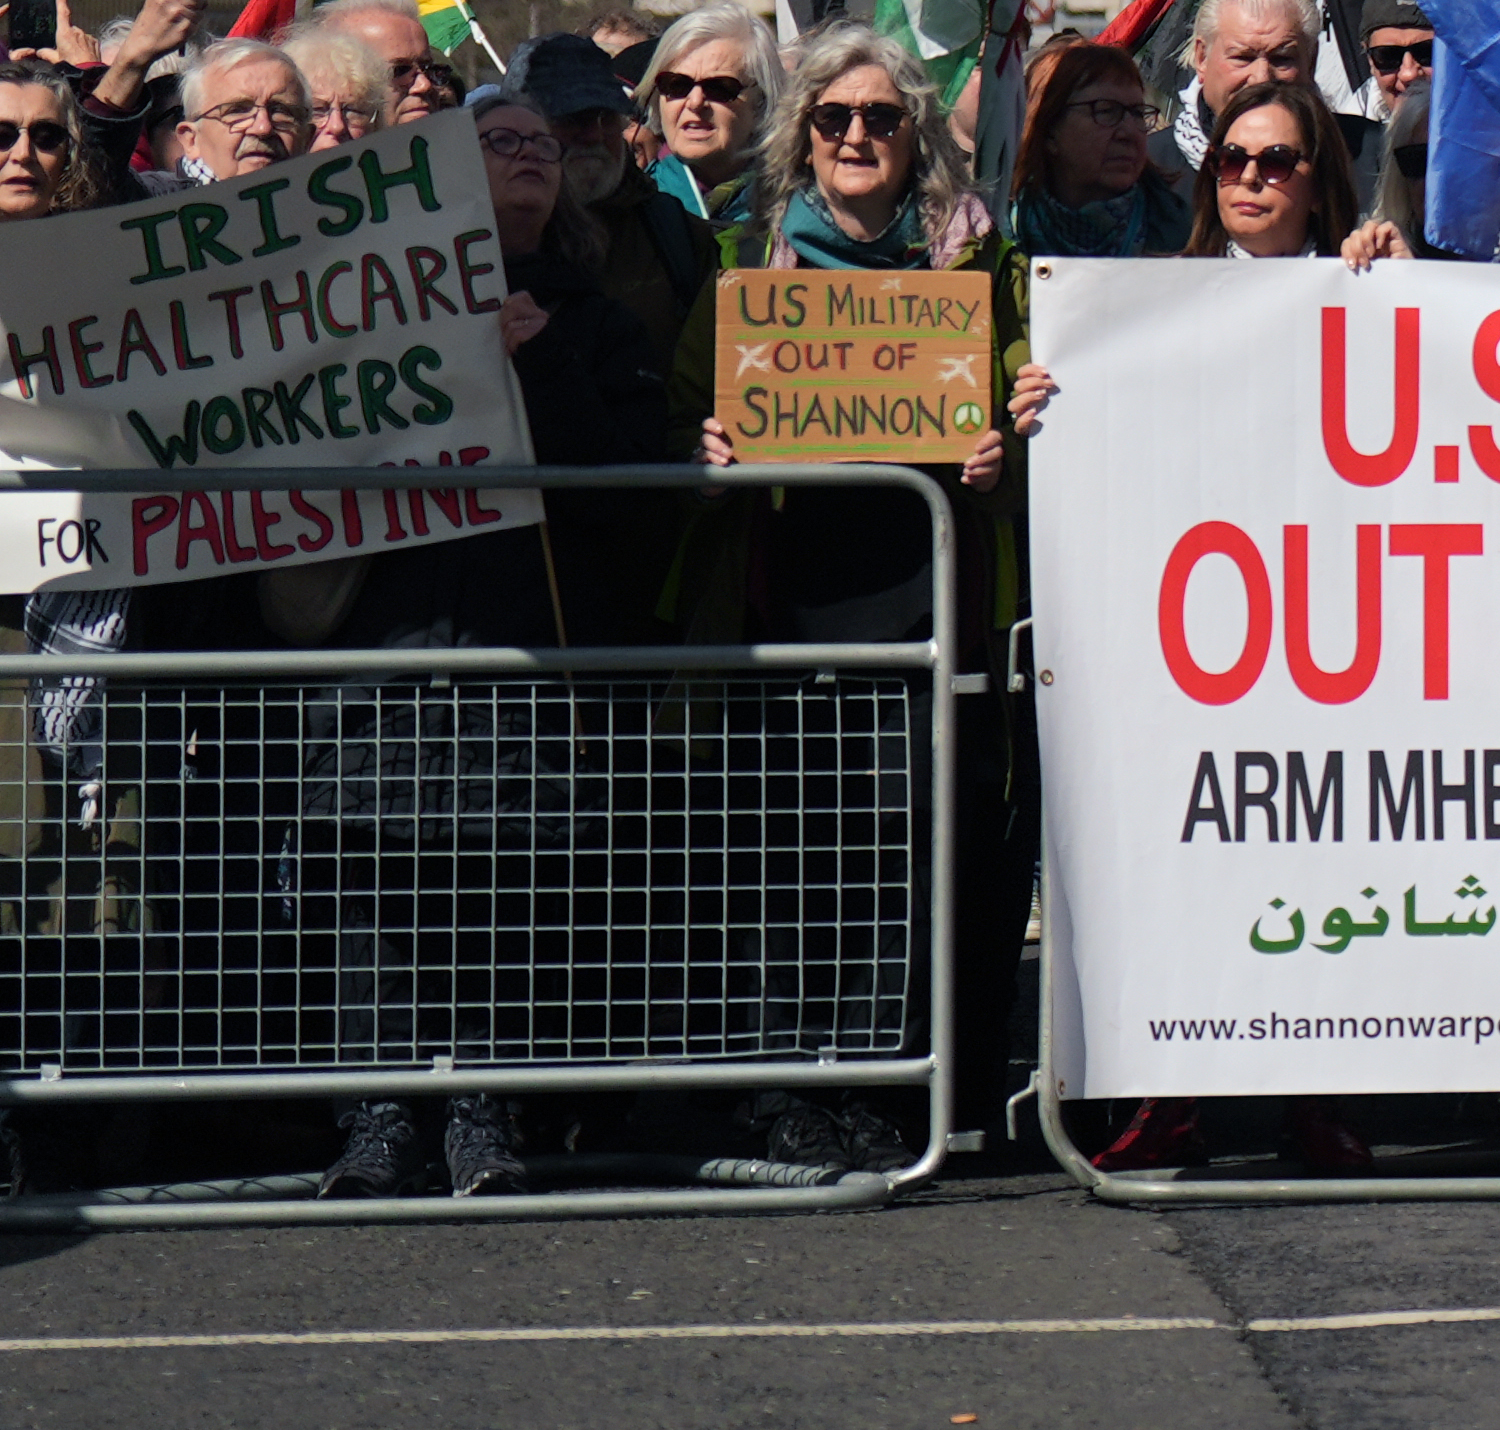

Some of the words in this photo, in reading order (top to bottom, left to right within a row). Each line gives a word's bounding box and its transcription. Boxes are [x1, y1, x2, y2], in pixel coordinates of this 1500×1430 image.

[120, 135, 441, 284] IRISH
[7, 229, 501, 399] HEALTHCARE
[738, 283, 808, 327] US
[772, 340, 854, 374] OUT
[873, 342, 917, 371] OF
[127, 345, 453, 469] WORKERS
[736, 386, 946, 439] SHANNON
[38, 517, 108, 567] FOR
[1159, 521, 1484, 707] OUT
[1181, 750, 1343, 842] ARM
[1250, 874, 1497, 952] شانون
